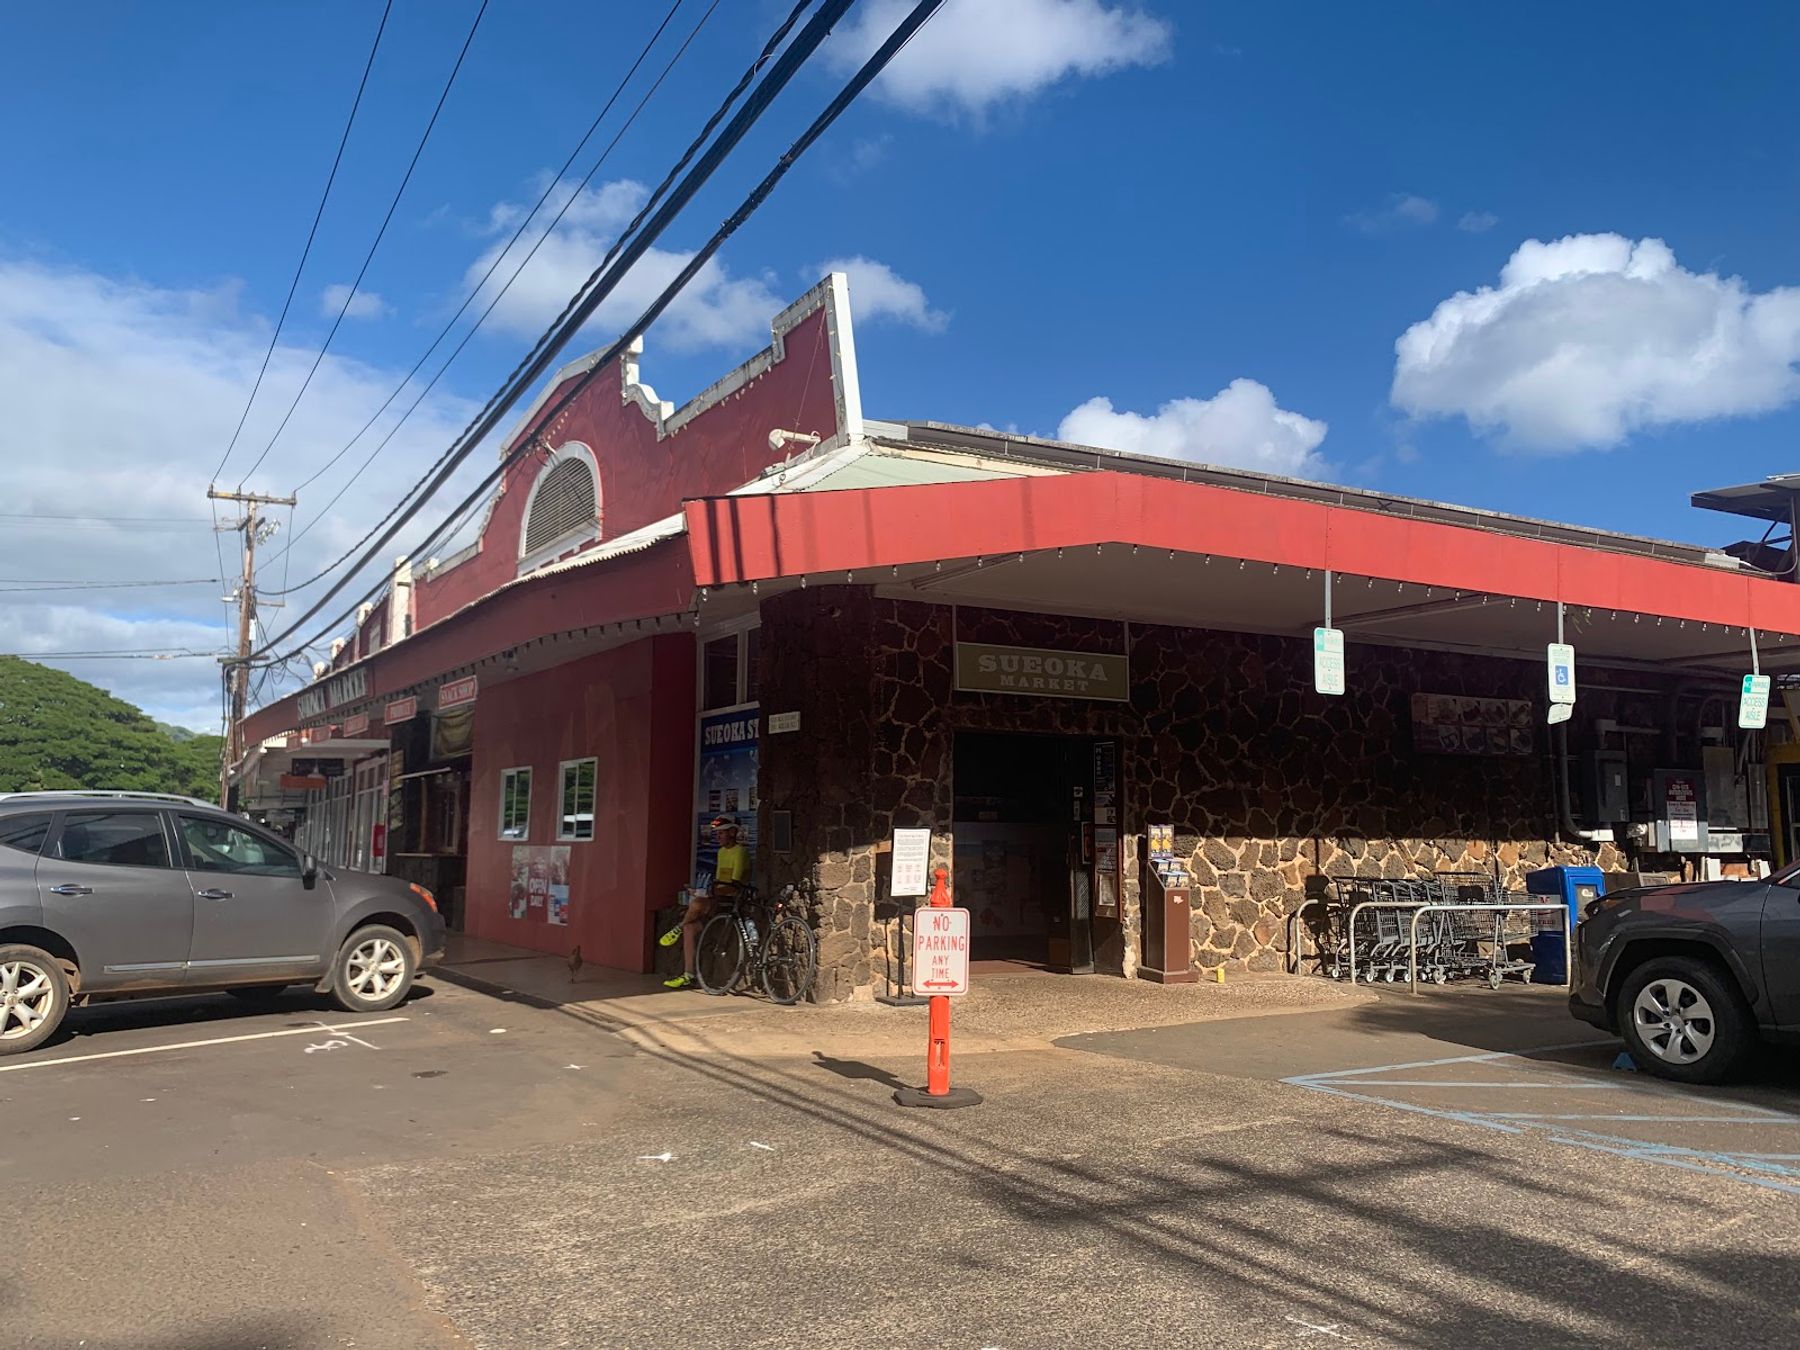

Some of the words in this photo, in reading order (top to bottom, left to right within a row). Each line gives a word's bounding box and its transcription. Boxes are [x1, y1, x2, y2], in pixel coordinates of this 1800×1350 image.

[977, 654, 1108, 681] SUEOKA
[1000, 675, 1089, 691] MARKET
[1744, 696, 1766, 707] ACCESS
[1745, 710, 1761, 720] AISLE
[705, 721, 745, 745] SUEOKA
[933, 915, 949, 931] NO
[918, 936, 965, 951] PARKING
[932, 955, 949, 966] ANY
[932, 968, 949, 979] TIME
